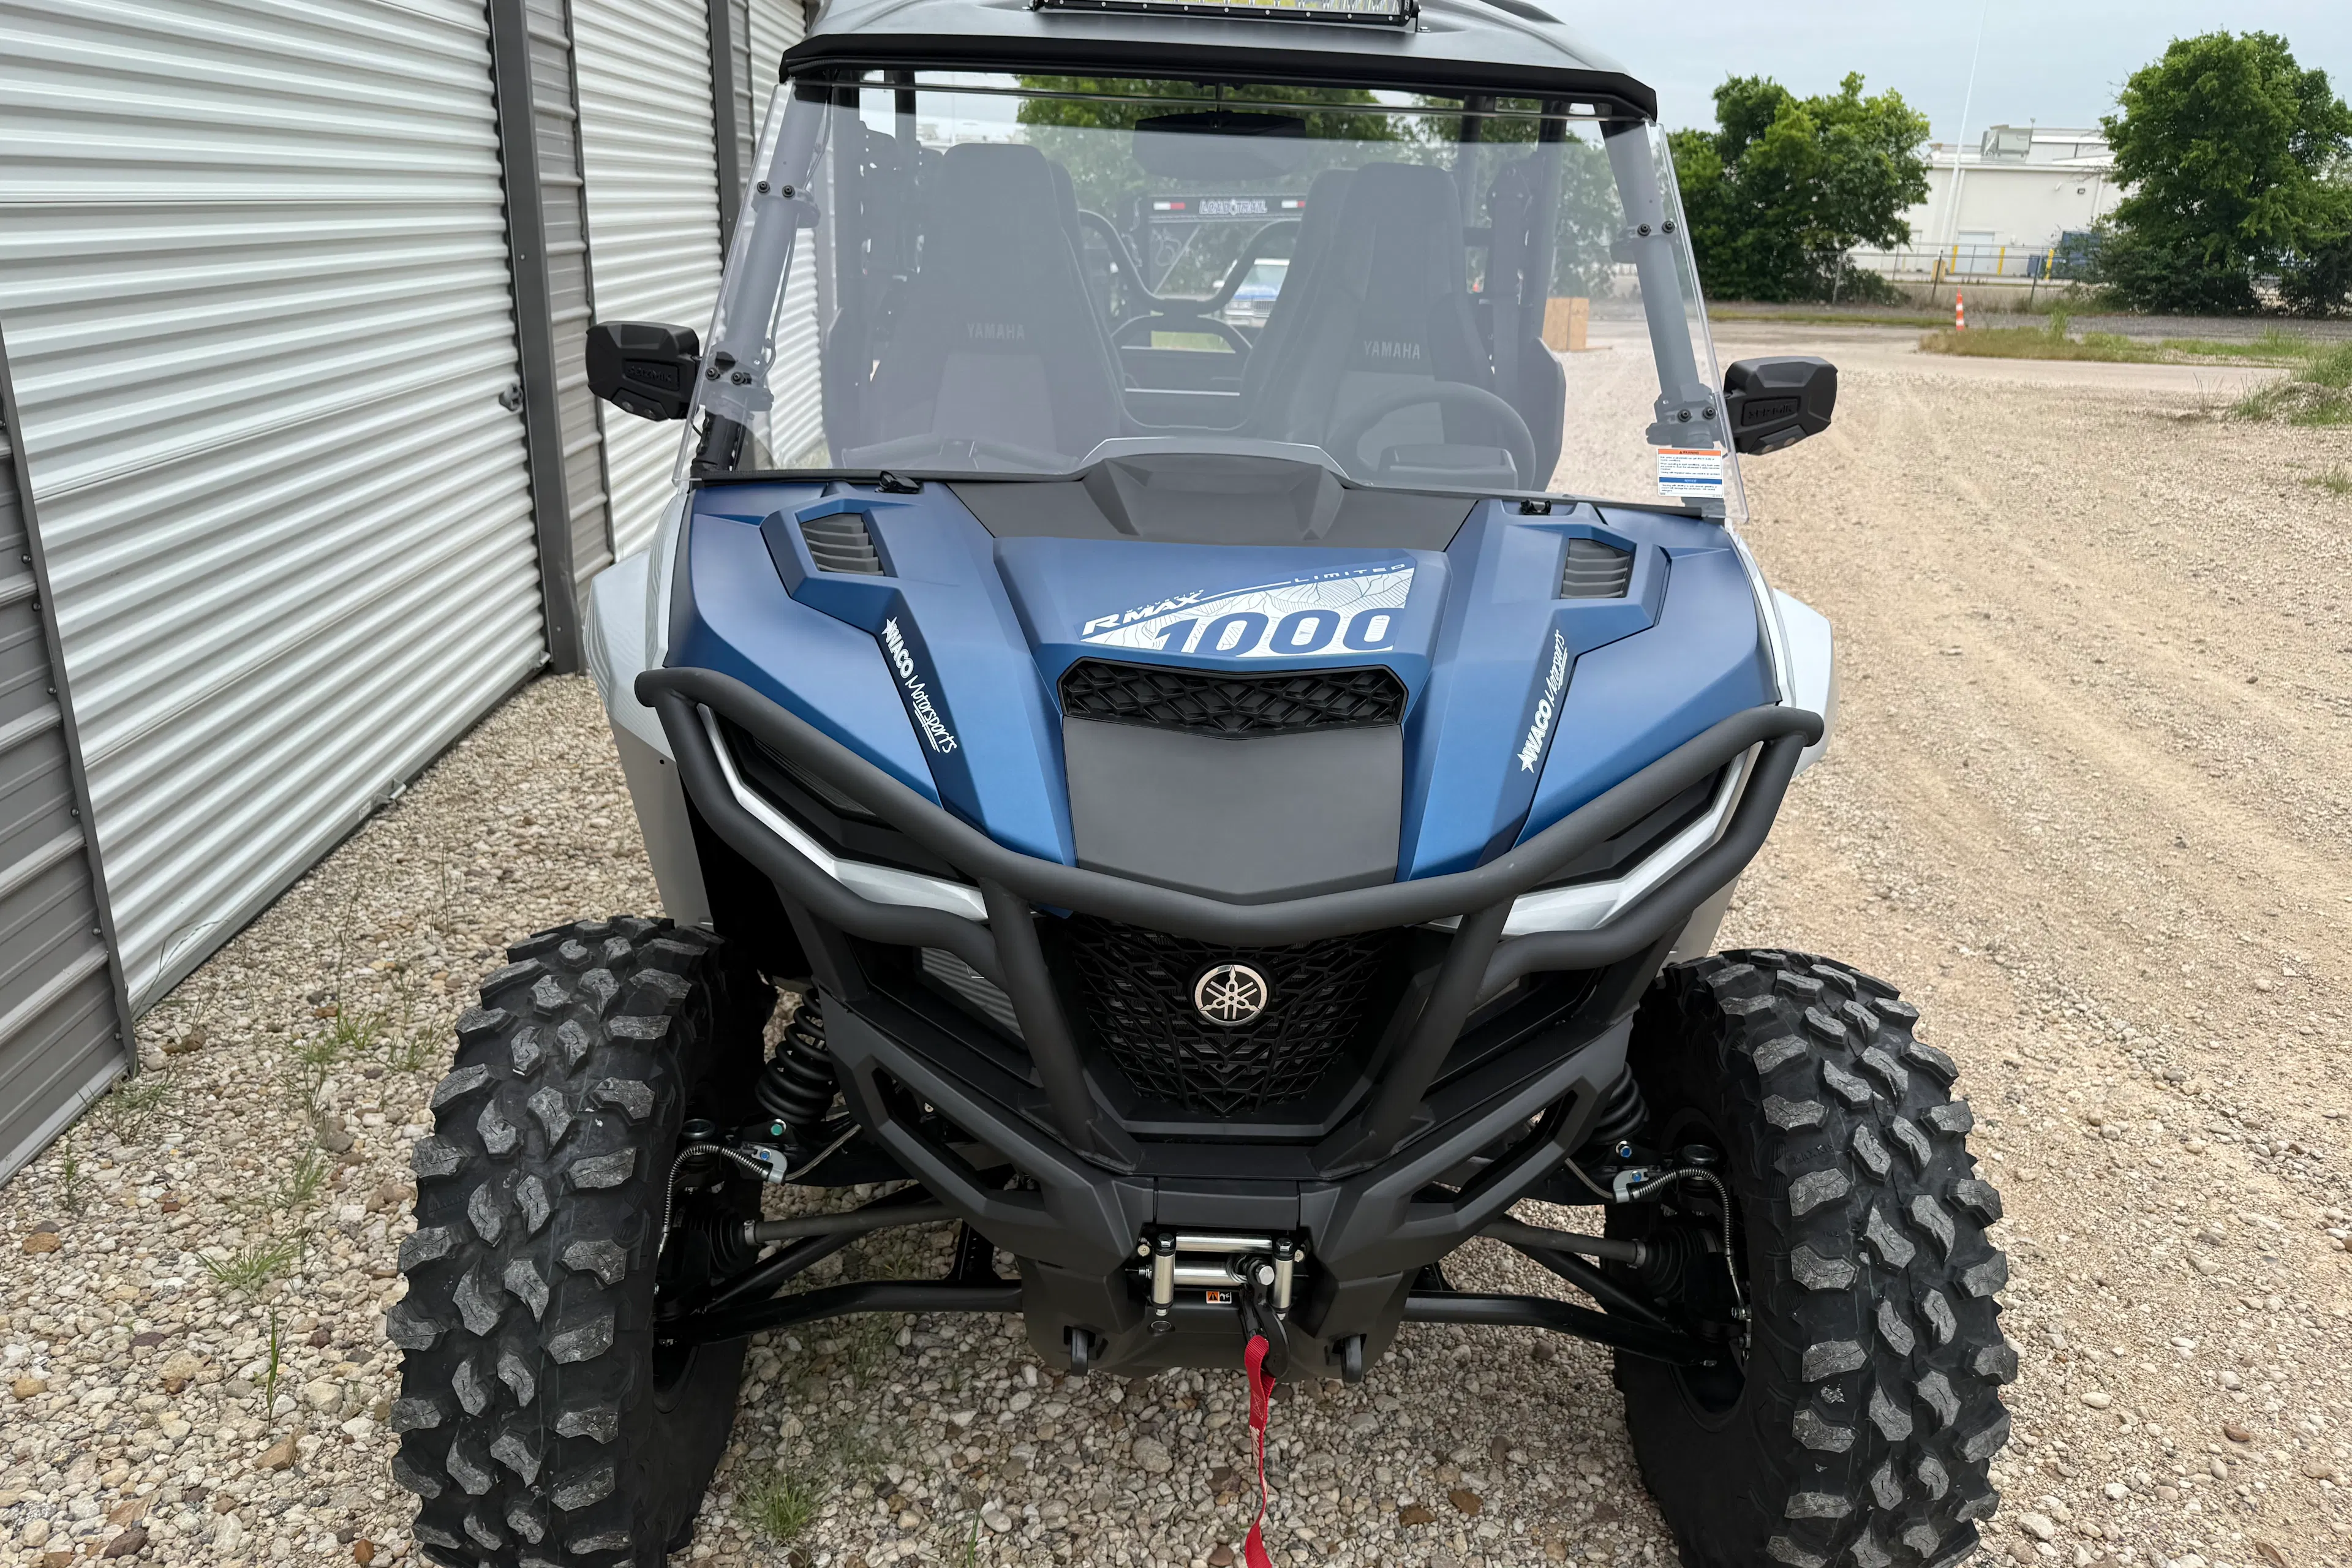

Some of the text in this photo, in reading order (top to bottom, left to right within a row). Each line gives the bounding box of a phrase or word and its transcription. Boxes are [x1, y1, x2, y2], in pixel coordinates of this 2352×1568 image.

[967, 322, 1025, 341] YAMAHA
[1363, 340, 1420, 360] YAMAHA
[1294, 564, 1406, 582] LIMITED
[1082, 592, 1202, 635] RMAX
[1153, 608, 1398, 657] 1000
[886, 623, 957, 753] WACO Motorsports
[1522, 699, 1552, 761] WACO
